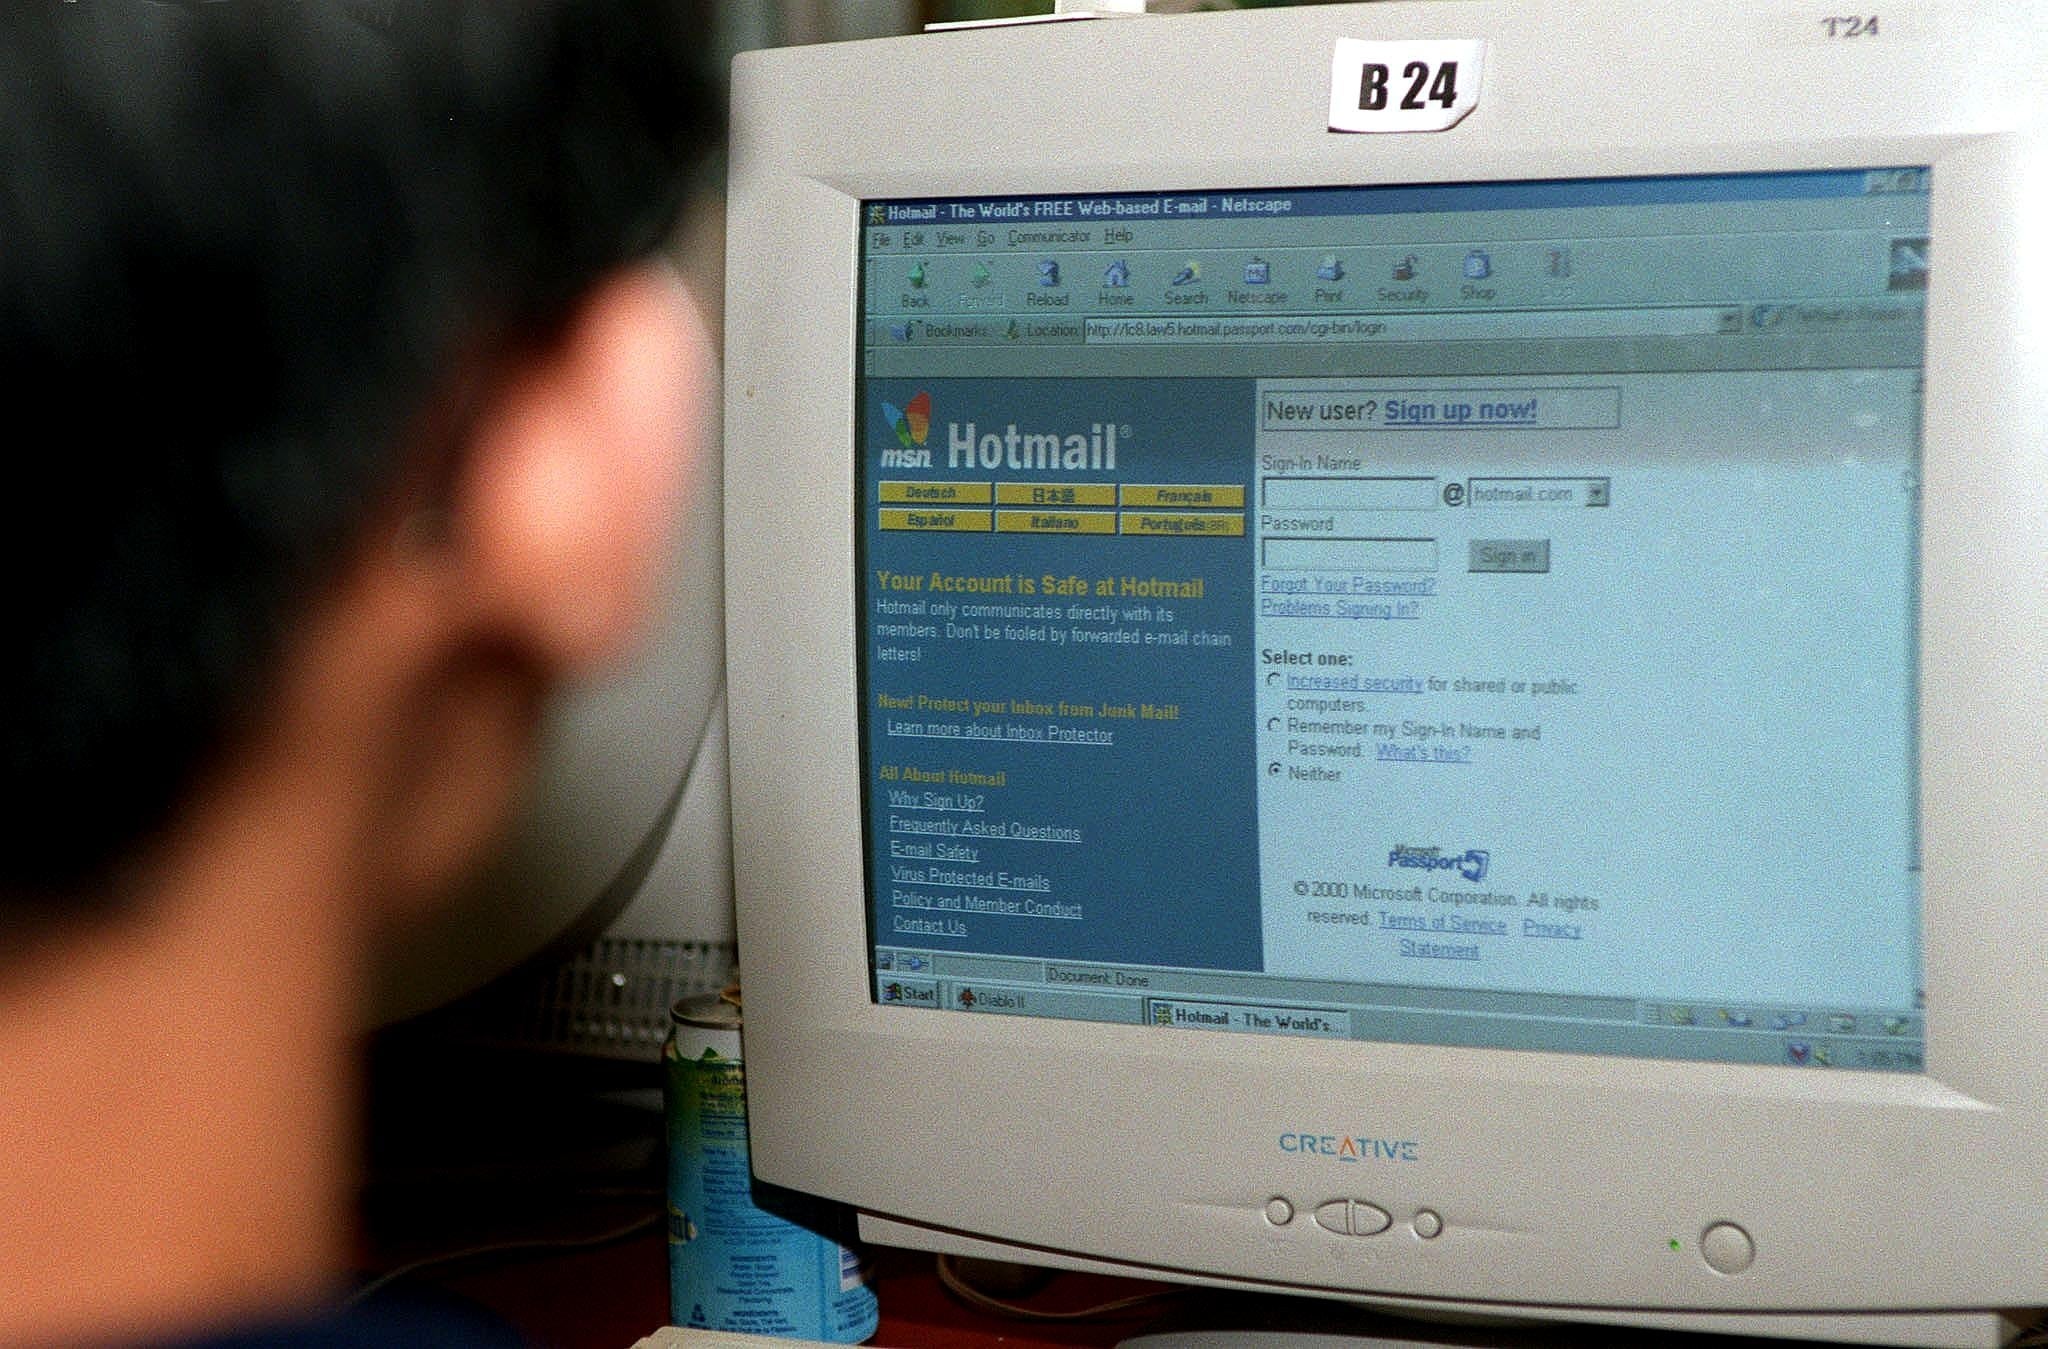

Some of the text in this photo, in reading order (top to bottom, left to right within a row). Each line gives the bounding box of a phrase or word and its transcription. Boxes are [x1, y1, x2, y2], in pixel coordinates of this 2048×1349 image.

[1821, 16, 1879, 37] T24
[1358, 60, 1458, 110] B 24
[888, 206, 936, 221] Hotmail
[951, 203, 975, 219] The
[979, 201, 1031, 218] World's
[1034, 200, 1073, 217] FREE
[1079, 199, 1159, 216] Web-based
[1164, 198, 1208, 214] E-mail
[1223, 197, 1293, 215] Netscape
[978, 230, 995, 247] Go
[1008, 227, 1091, 246] Communicator
[1104, 227, 1135, 245] Help
[902, 295, 929, 308] Back
[1027, 292, 1070, 306] Reload
[1099, 291, 1134, 305] Home
[1164, 290, 1208, 305] Search
[1228, 289, 1288, 305] Netscape
[1376, 288, 1429, 303] Security
[1461, 284, 1496, 300] Shop
[1267, 399, 1538, 424] New user? Sign up now!
[881, 447, 932, 468] msn
[1262, 456, 1362, 472] Sign-In Name
[905, 487, 957, 500] Deutsch
[1443, 482, 1466, 507] @
[1474, 483, 1574, 502] hotmail.com
[907, 512, 955, 528] Español
[1031, 516, 1080, 531] Italiano
[1261, 515, 1335, 532] Password
[1480, 547, 1515, 564] Sign
[877, 571, 1205, 599] Your Account is Safe at Hotmail
[1260, 576, 1437, 594] Forgot Your Password?
[877, 599, 1174, 624] Hotmail only communicates directly with its
[1260, 600, 1421, 619] Problems Signing In?
[946, 622, 979, 640] Don't
[984, 622, 1000, 641] be
[1004, 623, 1046, 642] fooled
[1051, 625, 1066, 646] by
[1071, 626, 1139, 645] forwarded
[1144, 627, 1189, 646] e-mail
[1193, 630, 1232, 647] chain
[877, 645, 921, 663] letters!
[1262, 649, 1354, 667] Select one:
[1287, 674, 1577, 697] Increased security for shared or public
[879, 694, 1181, 721] New! Protect your Inbox from Junk Mail!
[888, 719, 1114, 743] Learn more about Inbox Protector
[1287, 717, 1368, 735] Remember
[1372, 723, 1396, 740] my
[1461, 723, 1506, 740] Name
[1510, 724, 1541, 741] and
[1377, 742, 1430, 761] What's
[1433, 744, 1472, 763] this?
[880, 766, 1007, 787] All About Hotmail
[1288, 764, 1342, 782] Neither
[889, 791, 985, 811] Why Sign Up?
[890, 815, 1081, 842] Frequently Asked Questions
[891, 840, 979, 861] E-mail Safety
[1388, 850, 1463, 872] Passport
[890, 864, 1050, 890] Virus Protected E-mails
[892, 890, 1083, 917] Policy and Member Conduct
[1312, 881, 1348, 899] 2000
[1353, 883, 1423, 902] Microsoft
[1526, 892, 1549, 908] All
[1554, 894, 1600, 913] rights
[894, 915, 967, 936] Contact Us
[1379, 912, 1427, 931] Terms
[1432, 913, 1448, 931] of
[1451, 915, 1507, 935] Service
[1523, 918, 1582, 939] Privacy
[1399, 938, 1479, 960] Statement
[1114, 972, 1149, 987] Done
[903, 986, 934, 1001] Start
[979, 992, 1016, 1008] Diablo
[1176, 1008, 1230, 1025] Hotmail
[1244, 1013, 1272, 1029] The
[1280, 1133, 1418, 1162] CREATIVE
